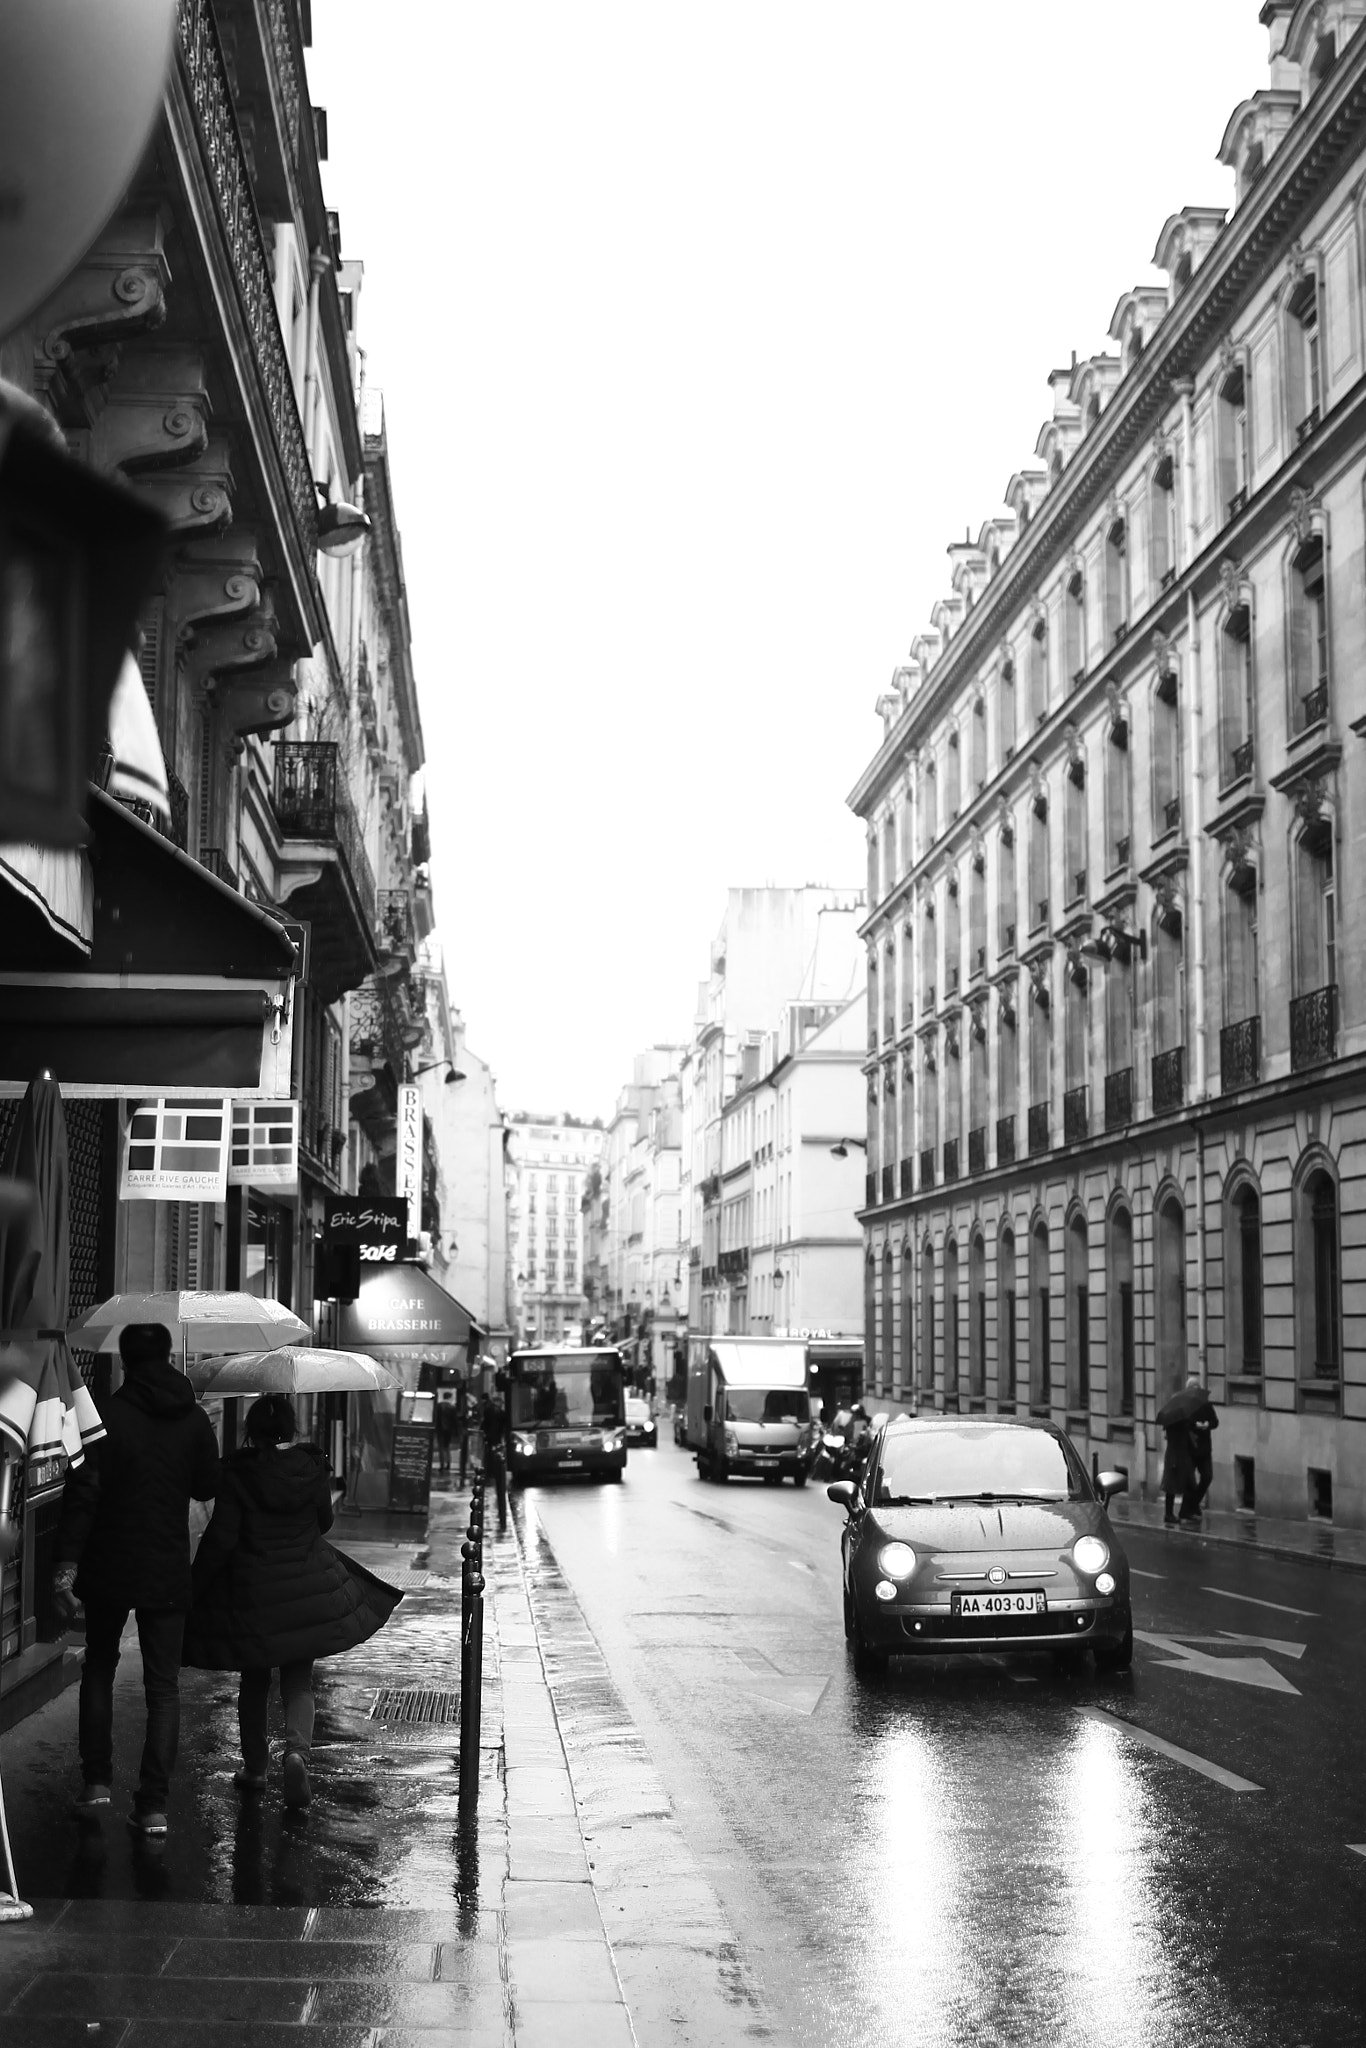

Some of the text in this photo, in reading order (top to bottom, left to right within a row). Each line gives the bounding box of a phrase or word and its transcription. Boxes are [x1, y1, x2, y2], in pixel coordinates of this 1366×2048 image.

[160, 1175, 180, 1183] RIVE
[182, 1175, 219, 1184] GAUCHE
[330, 1211, 357, 1228] Eric
[390, 1298, 425, 1310] CAFE
[368, 1319, 442, 1331] BRASSERIE
[789, 1327, 835, 1339] ROYAL
[375, 1351, 448, 1361] STAURANT
